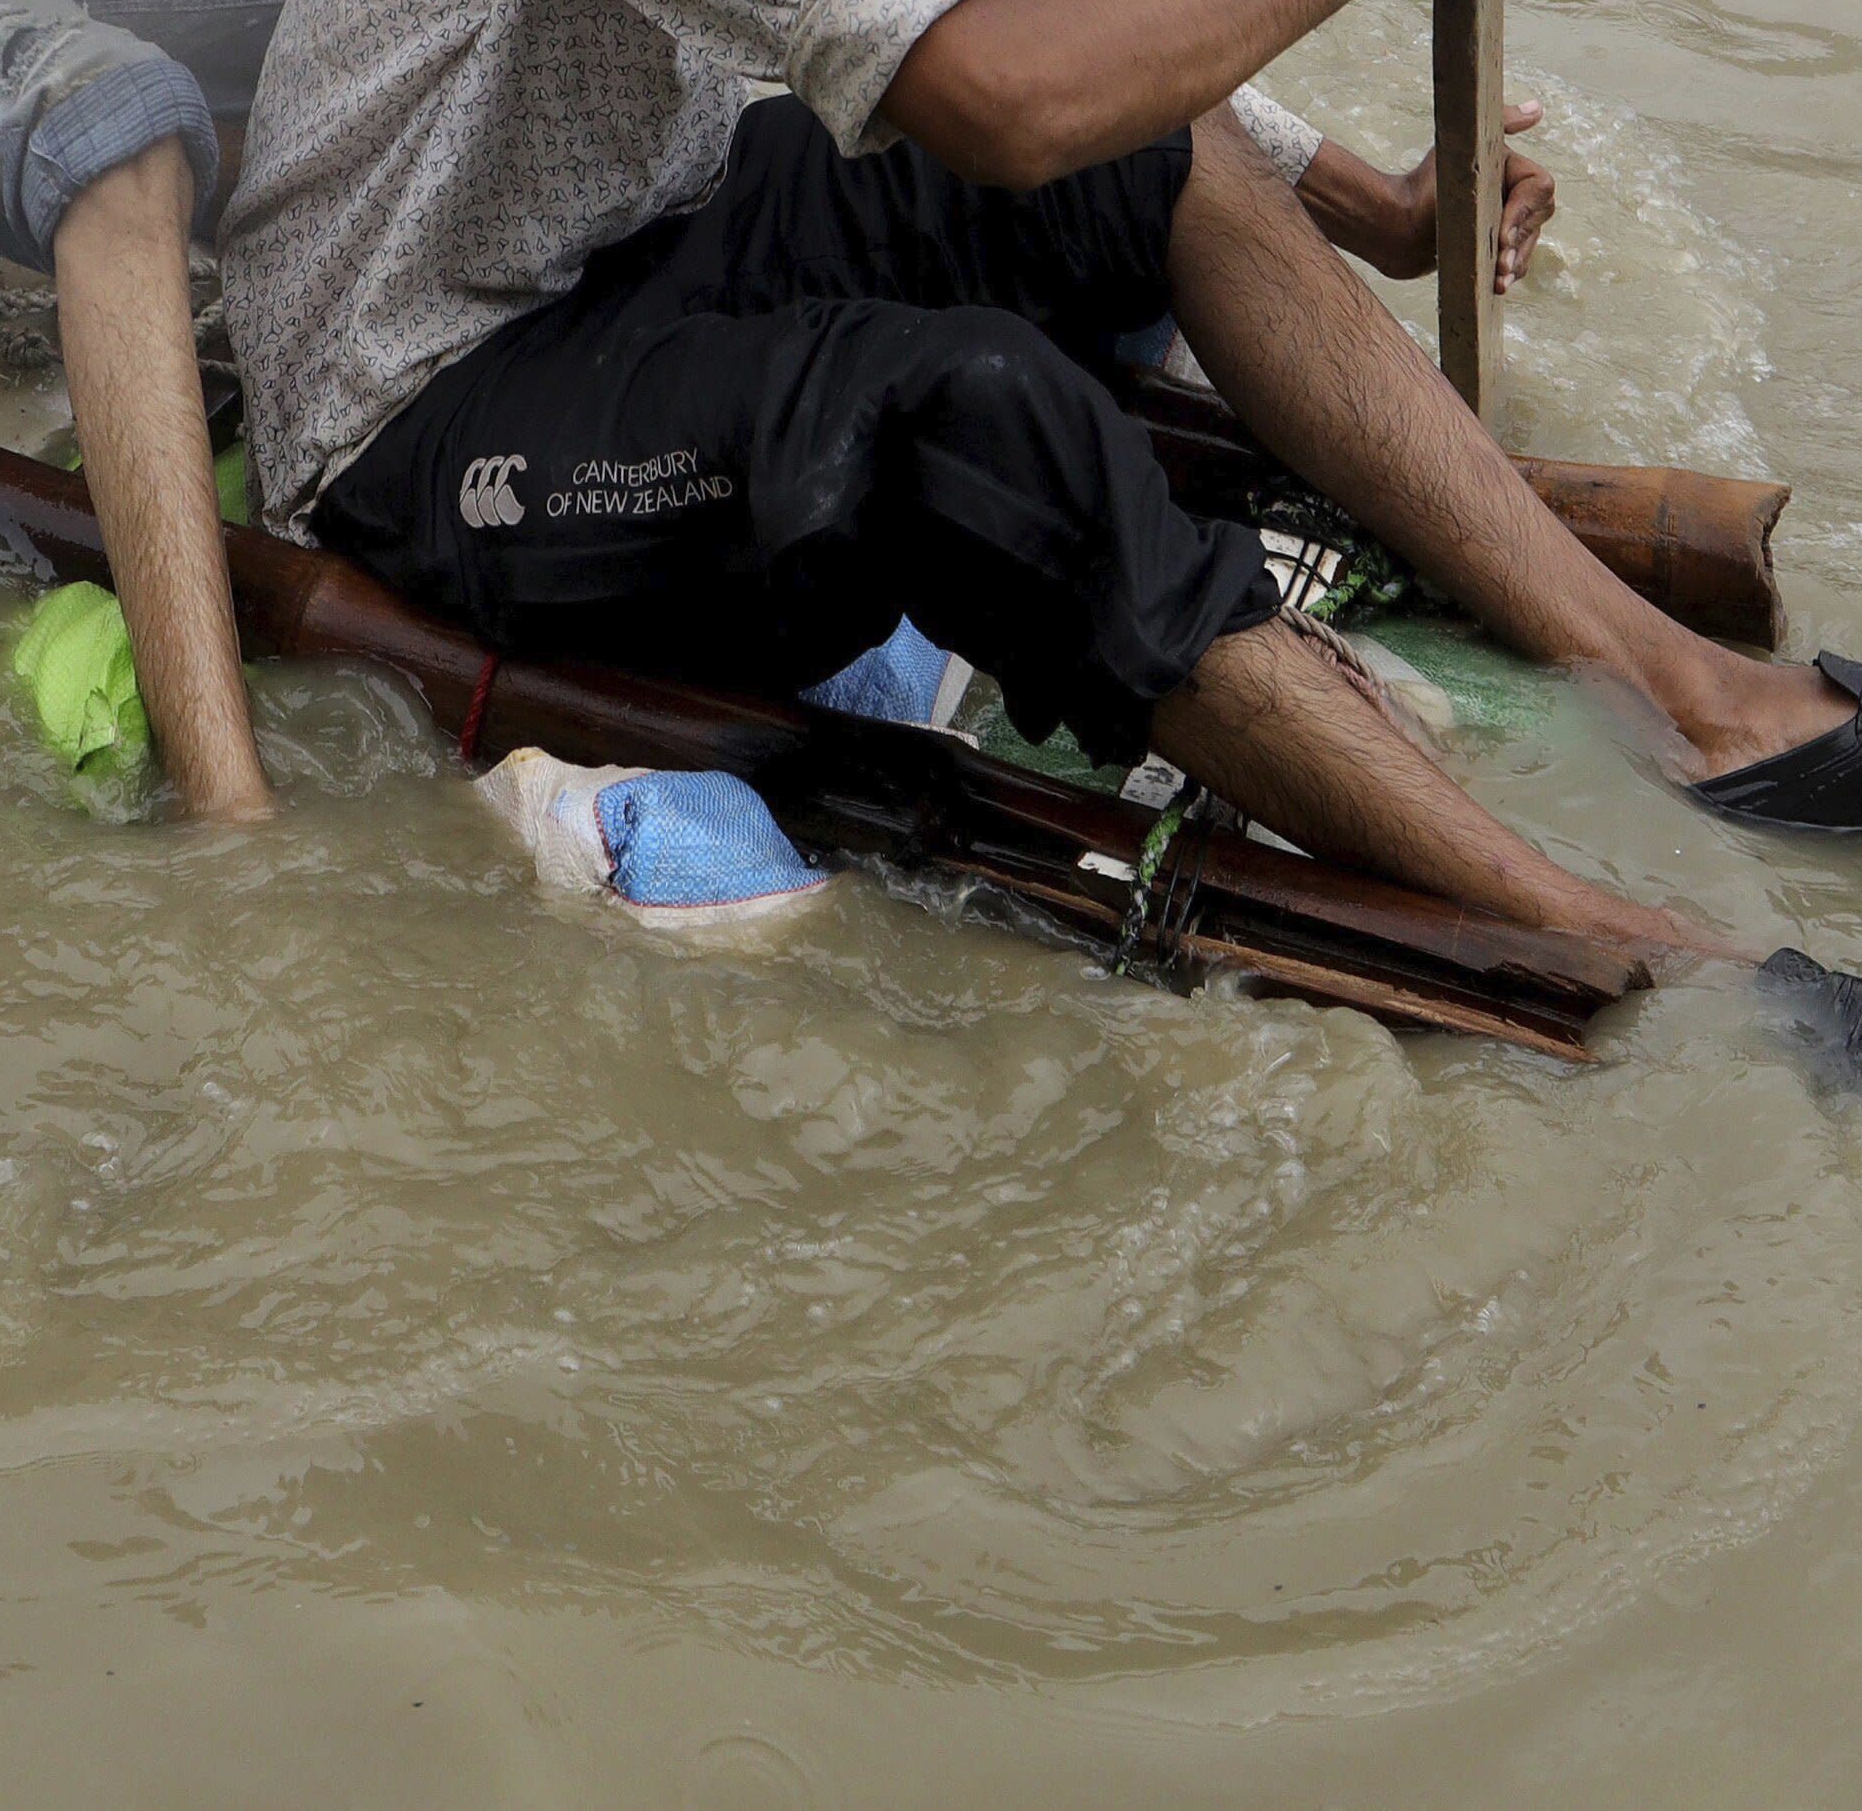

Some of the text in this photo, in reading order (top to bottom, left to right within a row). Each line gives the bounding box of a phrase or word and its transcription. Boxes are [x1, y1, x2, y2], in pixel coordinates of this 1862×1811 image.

[571, 447, 699, 487] CANTERBURY
[546, 474, 734, 518] OF NEW ZEALAND
